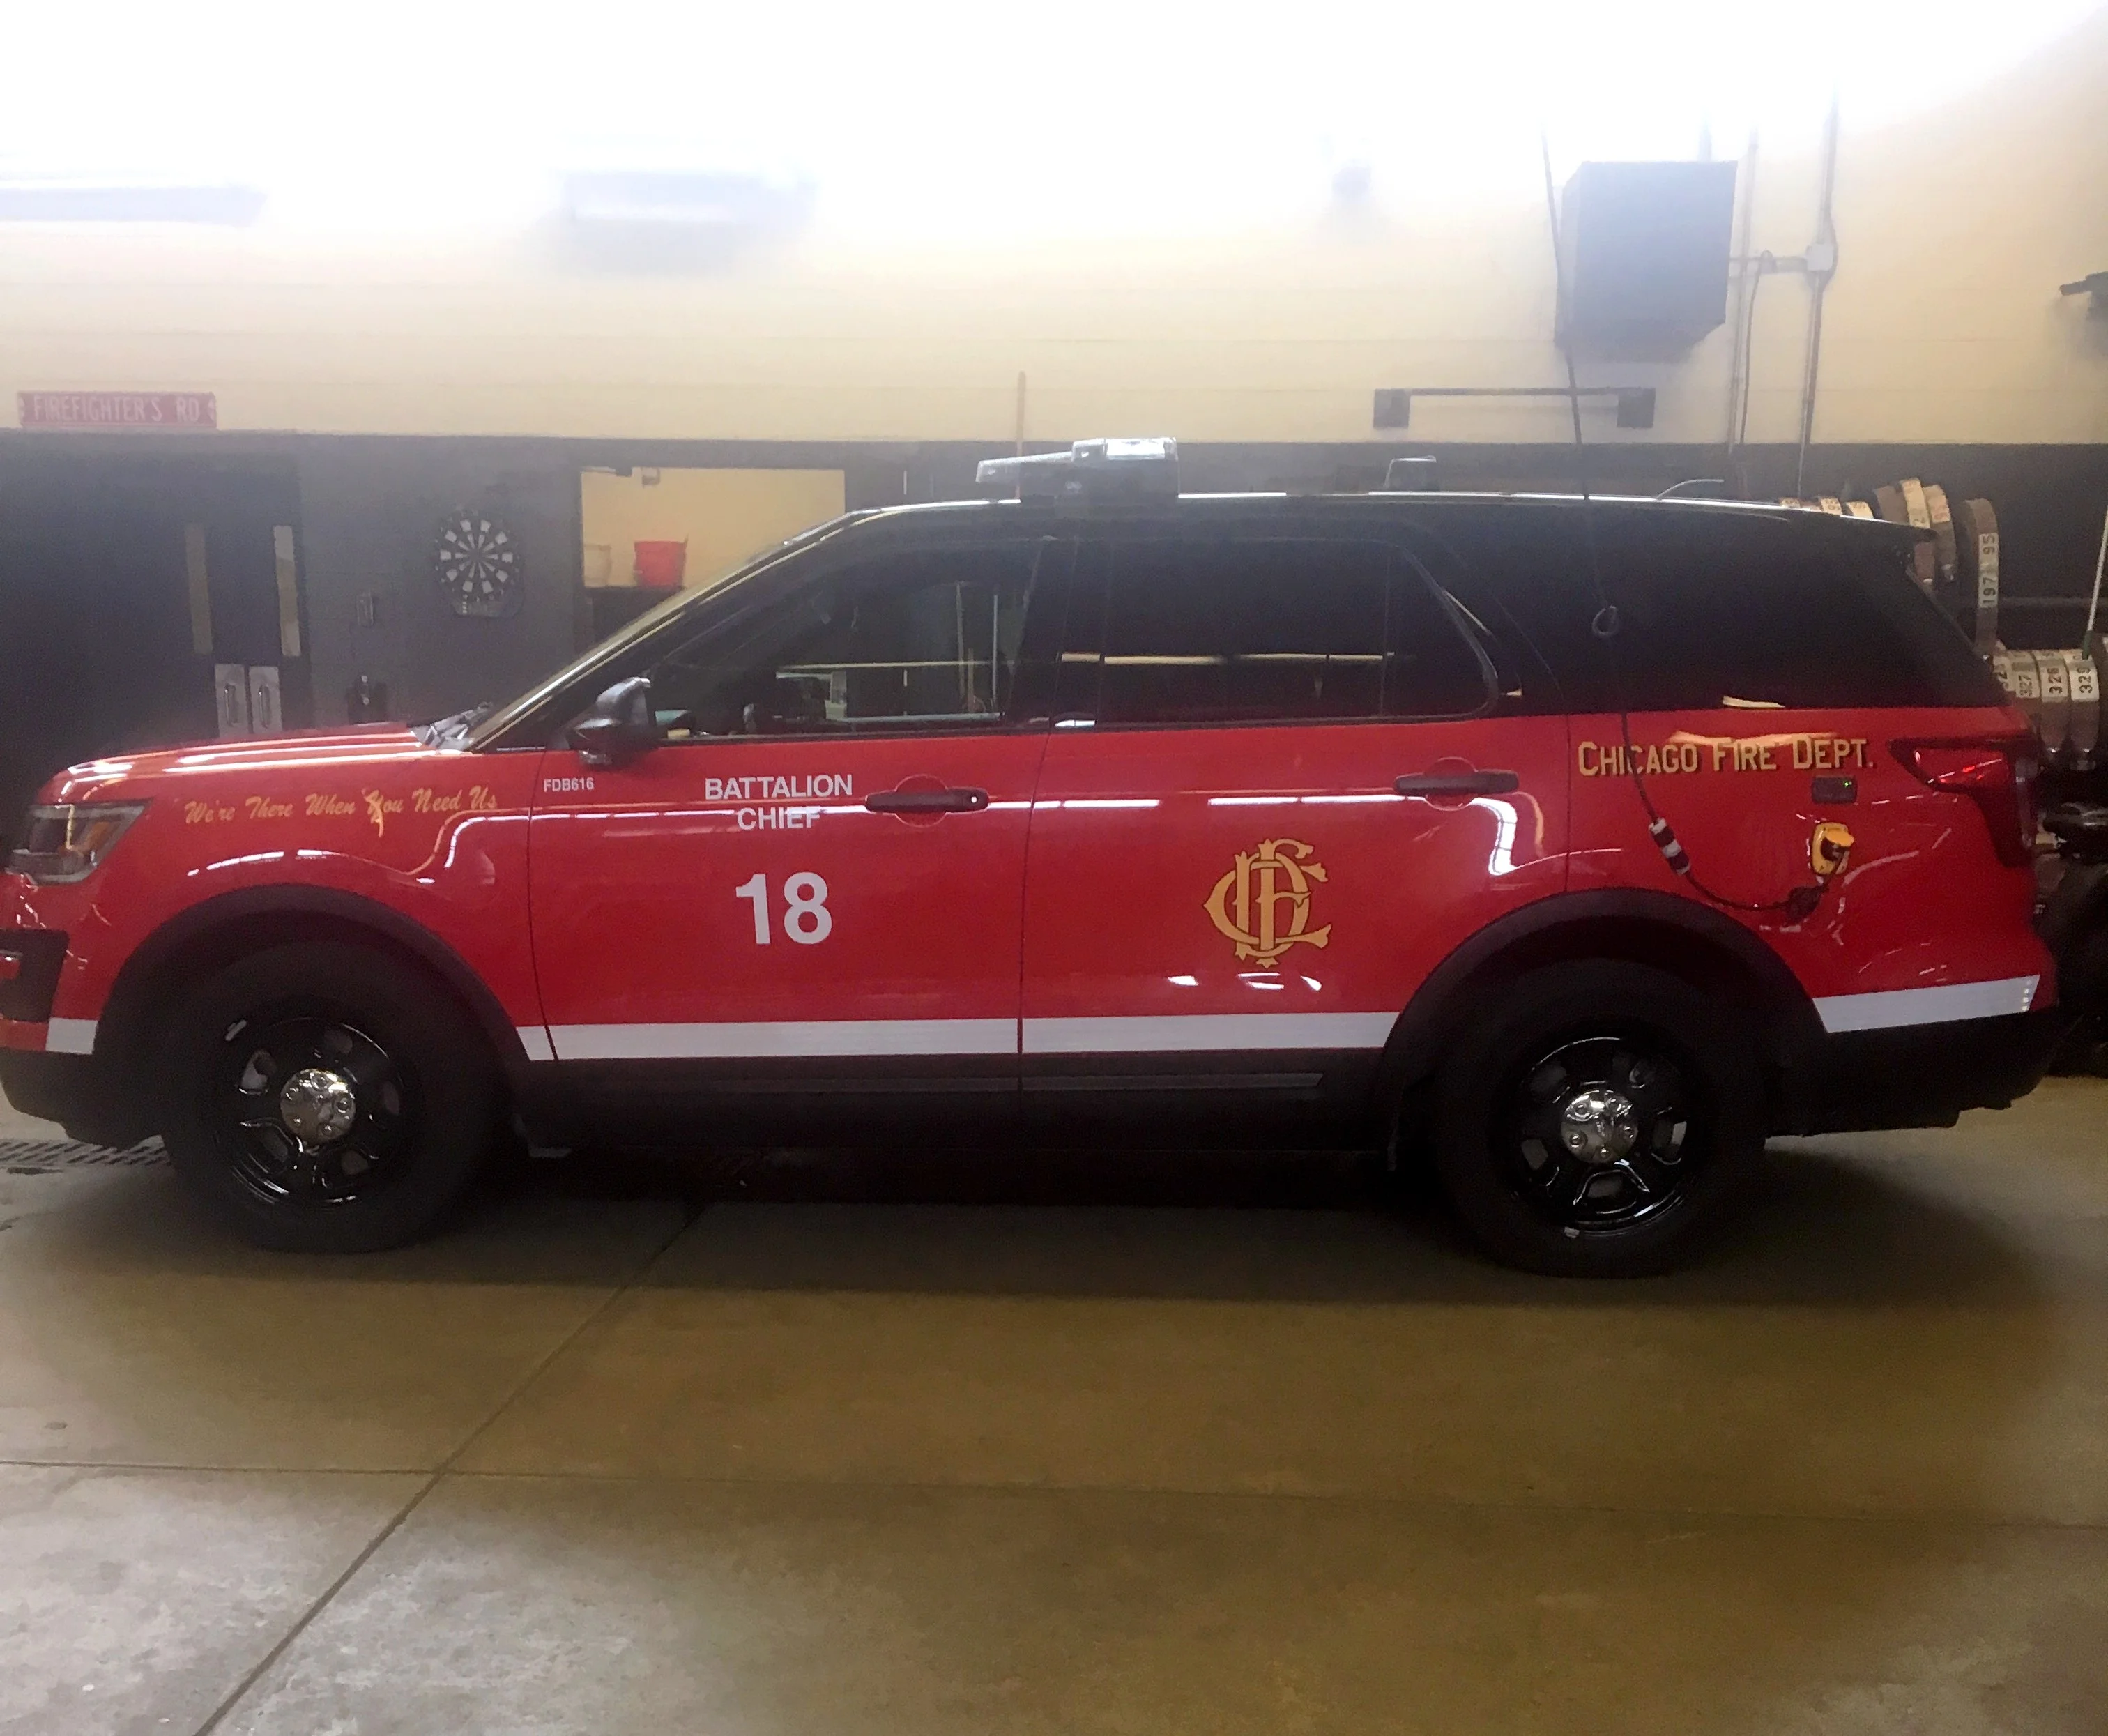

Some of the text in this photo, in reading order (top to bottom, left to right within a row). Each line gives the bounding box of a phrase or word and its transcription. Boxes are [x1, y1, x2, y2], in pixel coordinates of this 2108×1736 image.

[176, 395, 201, 422] RD
[1578, 735, 1875, 777] CHICAGO FIRE DEPT.
[544, 777, 594, 793] FDB616
[704, 774, 853, 801] BATTALION
[184, 784, 498, 824] We're There When You Need Us
[738, 807, 820, 830] CHIEF
[735, 871, 833, 945] 18
